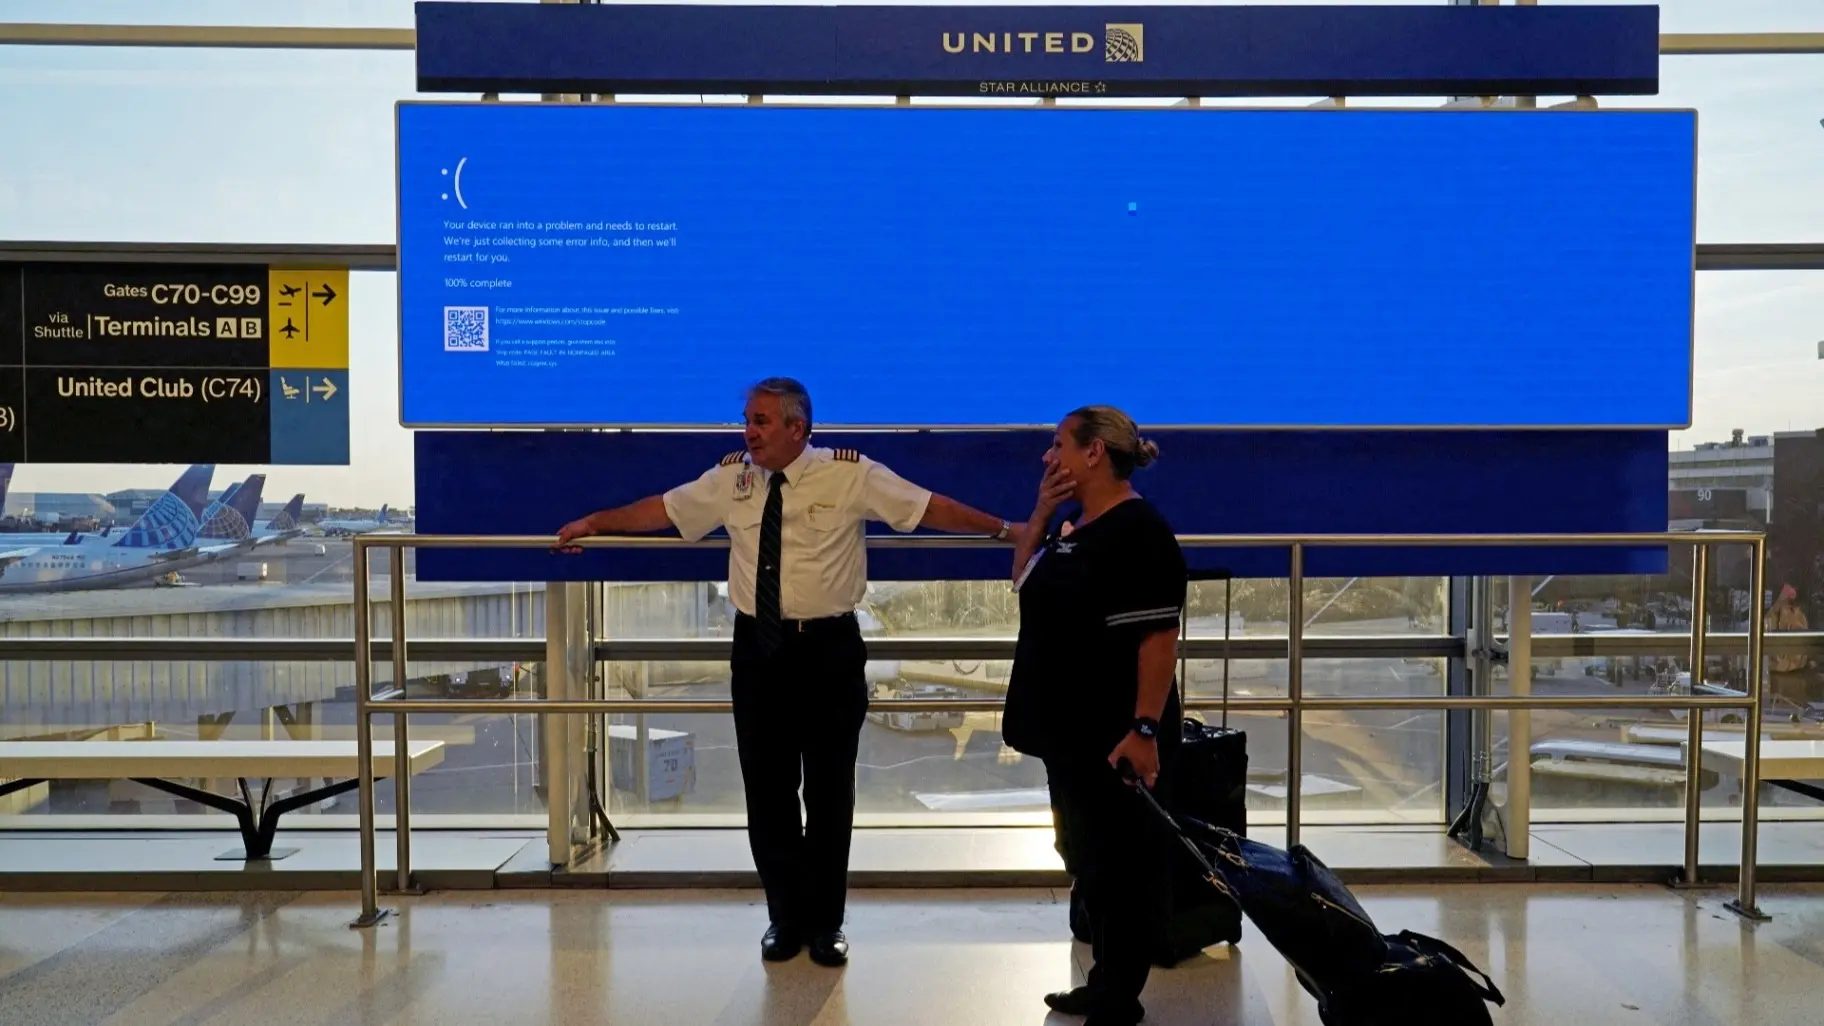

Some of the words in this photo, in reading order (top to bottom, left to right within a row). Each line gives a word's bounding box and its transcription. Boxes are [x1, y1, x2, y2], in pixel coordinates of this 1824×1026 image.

[942, 31, 1095, 54] UNITED
[979, 82, 1016, 93] STAR
[1019, 82, 1090, 93] ALLIANCE
[444, 220, 465, 230] Your
[467, 220, 497, 230] device
[499, 222, 514, 230] ran
[516, 221, 535, 230] into
[537, 222, 543, 230] a
[545, 220, 583, 232] problem
[585, 221, 604, 230] and
[605, 221, 633, 231] needs
[635, 222, 645, 231] to
[647, 222, 678, 231] restart.
[443, 236, 471, 246] We're
[473, 236, 490, 248] just
[492, 236, 537, 248] collecting
[565, 239, 587, 247] error
[590, 237, 610, 248] info,
[612, 237, 631, 247] and
[632, 237, 654, 247] then
[655, 237, 677, 247] we'll
[443, 253, 473, 262] restart
[475, 252, 489, 262] for
[491, 254, 510, 264] you.
[444, 278, 468, 288] 100%
[469, 278, 512, 290] complete
[103, 283, 148, 299] Gates
[151, 284, 261, 306] C70-C99
[48, 312, 69, 324] via
[34, 325, 84, 339] Shuttle
[94, 316, 211, 337] Terminals
[219, 320, 234, 336] A
[244, 320, 259, 336] B
[57, 376, 133, 398] United
[139, 376, 194, 398] Club
[200, 376, 261, 404] (C74)
[1697, 489, 1712, 501] 90
